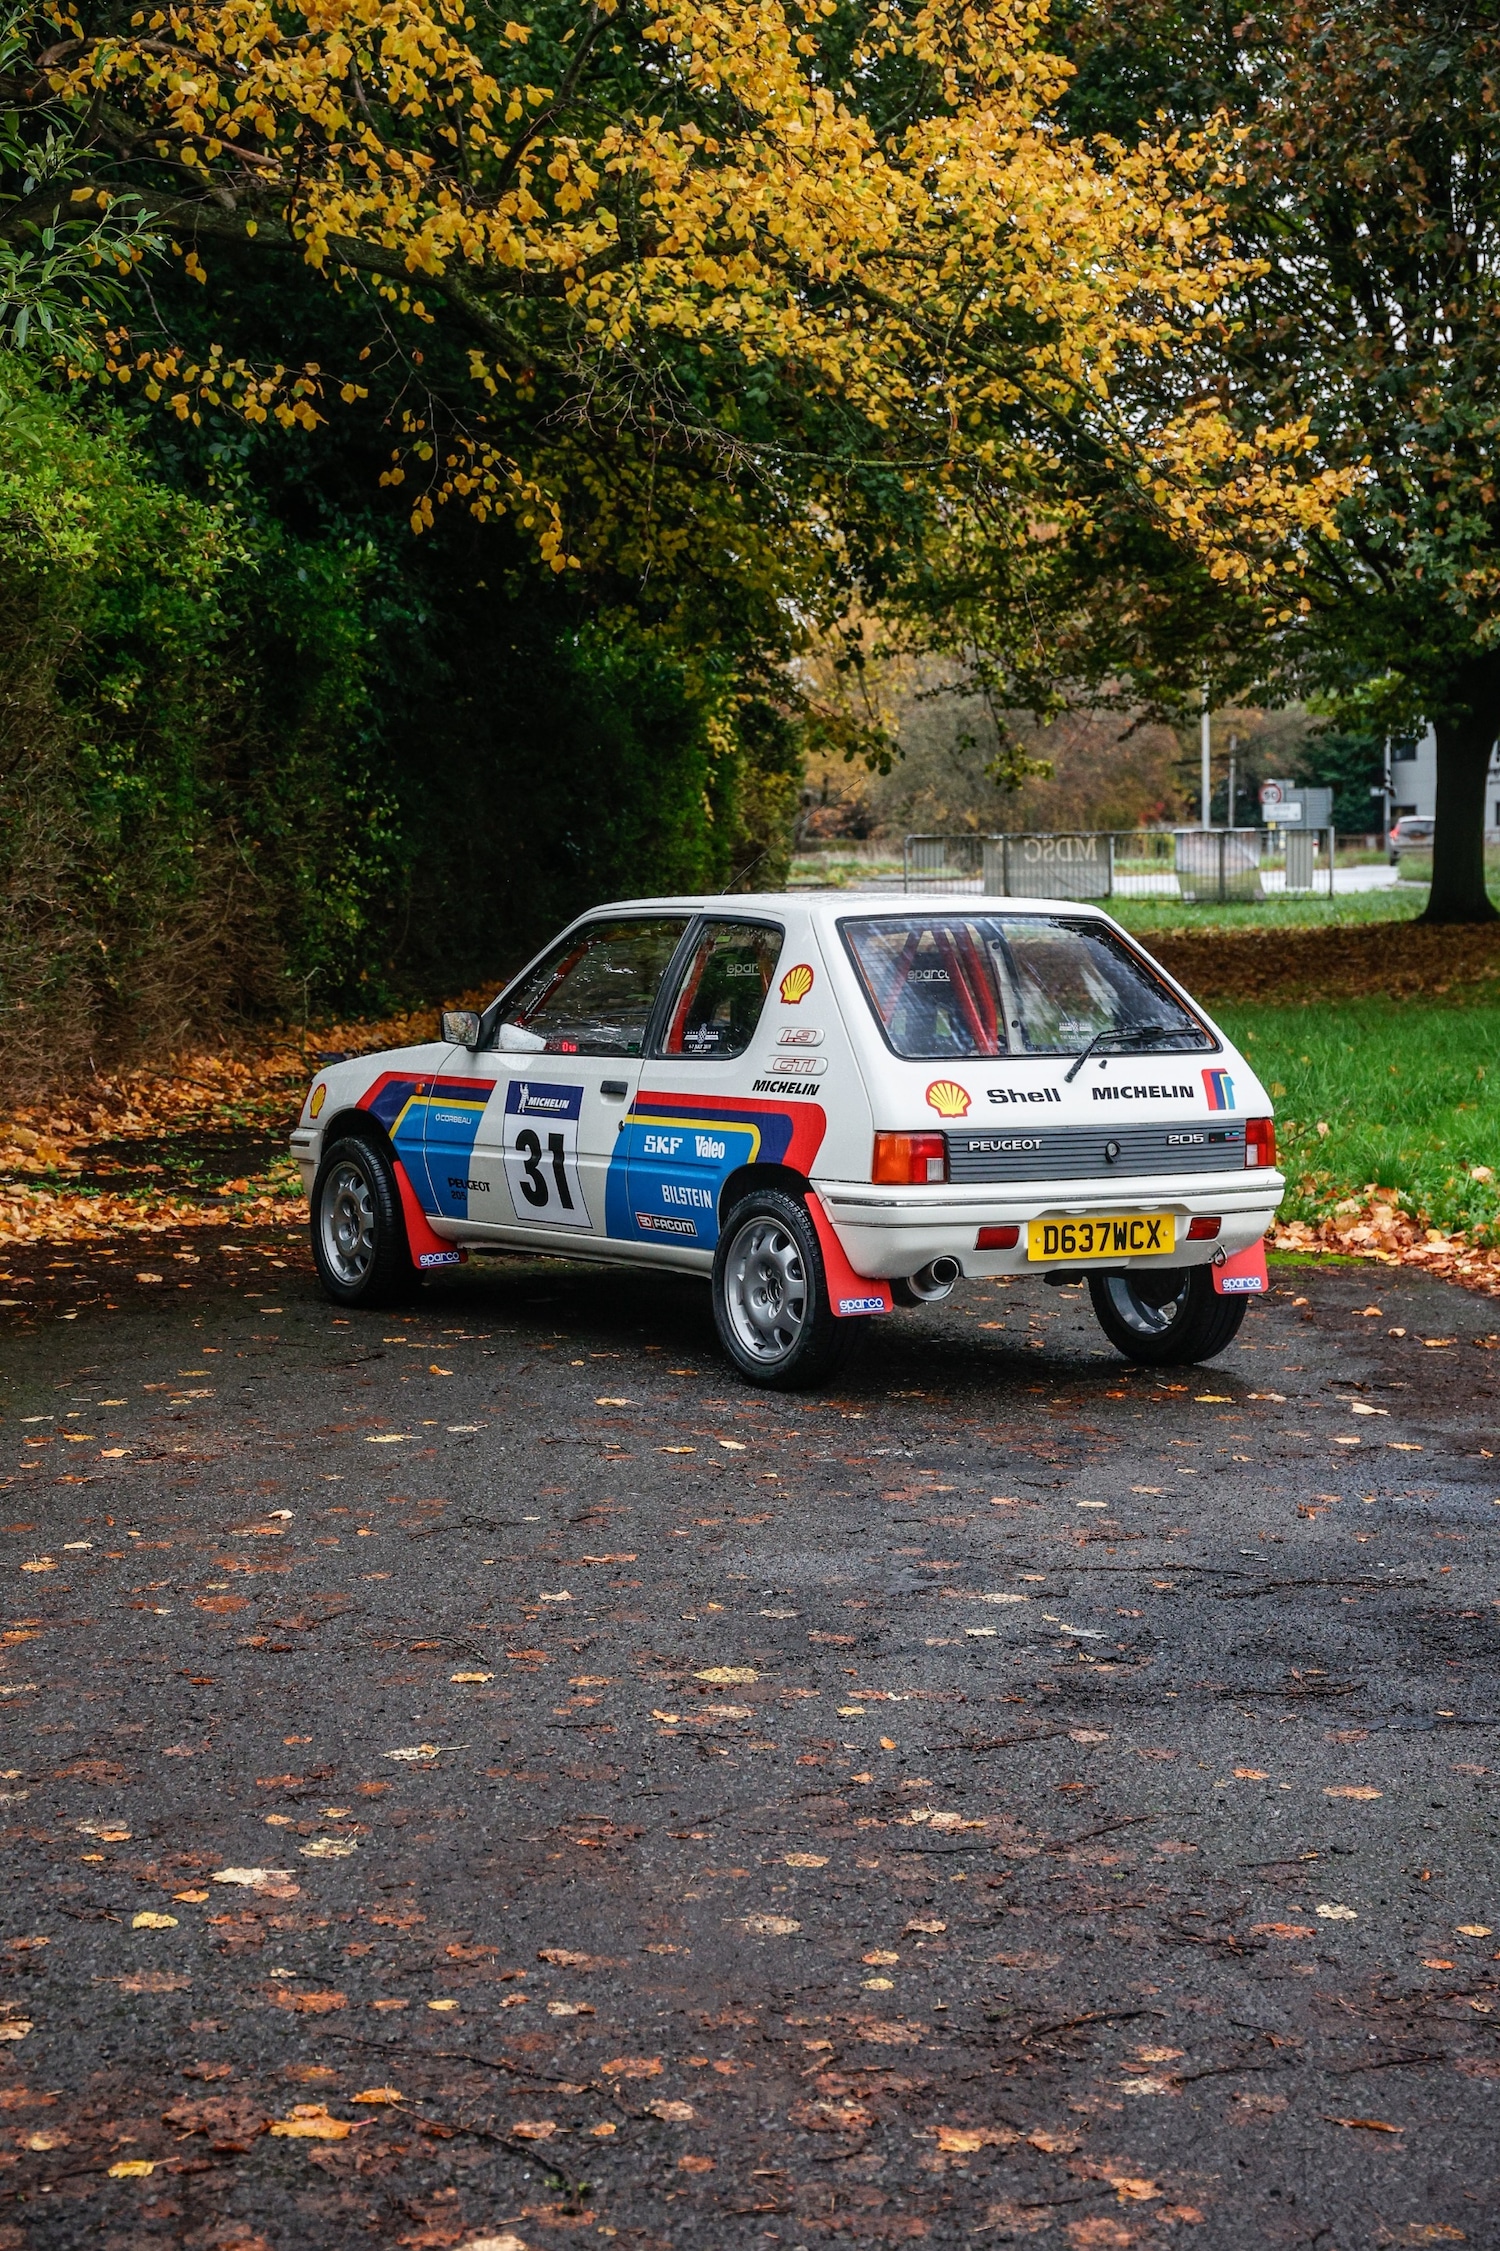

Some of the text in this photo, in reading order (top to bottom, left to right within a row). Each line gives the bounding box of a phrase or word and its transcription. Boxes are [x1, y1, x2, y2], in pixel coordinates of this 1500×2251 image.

[773, 1058, 816, 1072] GTI
[752, 1080, 820, 1096] MICHELIN
[987, 1088, 1061, 1103] Shell
[1092, 1086, 1194, 1100] MICHELIN
[528, 1096, 570, 1109] MICHELIN
[440, 1115, 472, 1124] CORBEAU
[968, 1140, 1042, 1151] PEUGEOT
[1168, 1134, 1204, 1144] 205
[644, 1135, 725, 1159] SKF Valeo
[516, 1129, 575, 1210] 31
[448, 1177, 490, 1192] PEUGEOT
[451, 1191, 467, 1200] 205
[661, 1185, 713, 1208] BILSTEIN
[653, 1218, 695, 1233] FACOM
[1043, 1220, 1161, 1255] D637WCX
[420, 1252, 460, 1267] sparco
[1222, 1277, 1262, 1291] sparco
[840, 1298, 884, 1314] sparco
